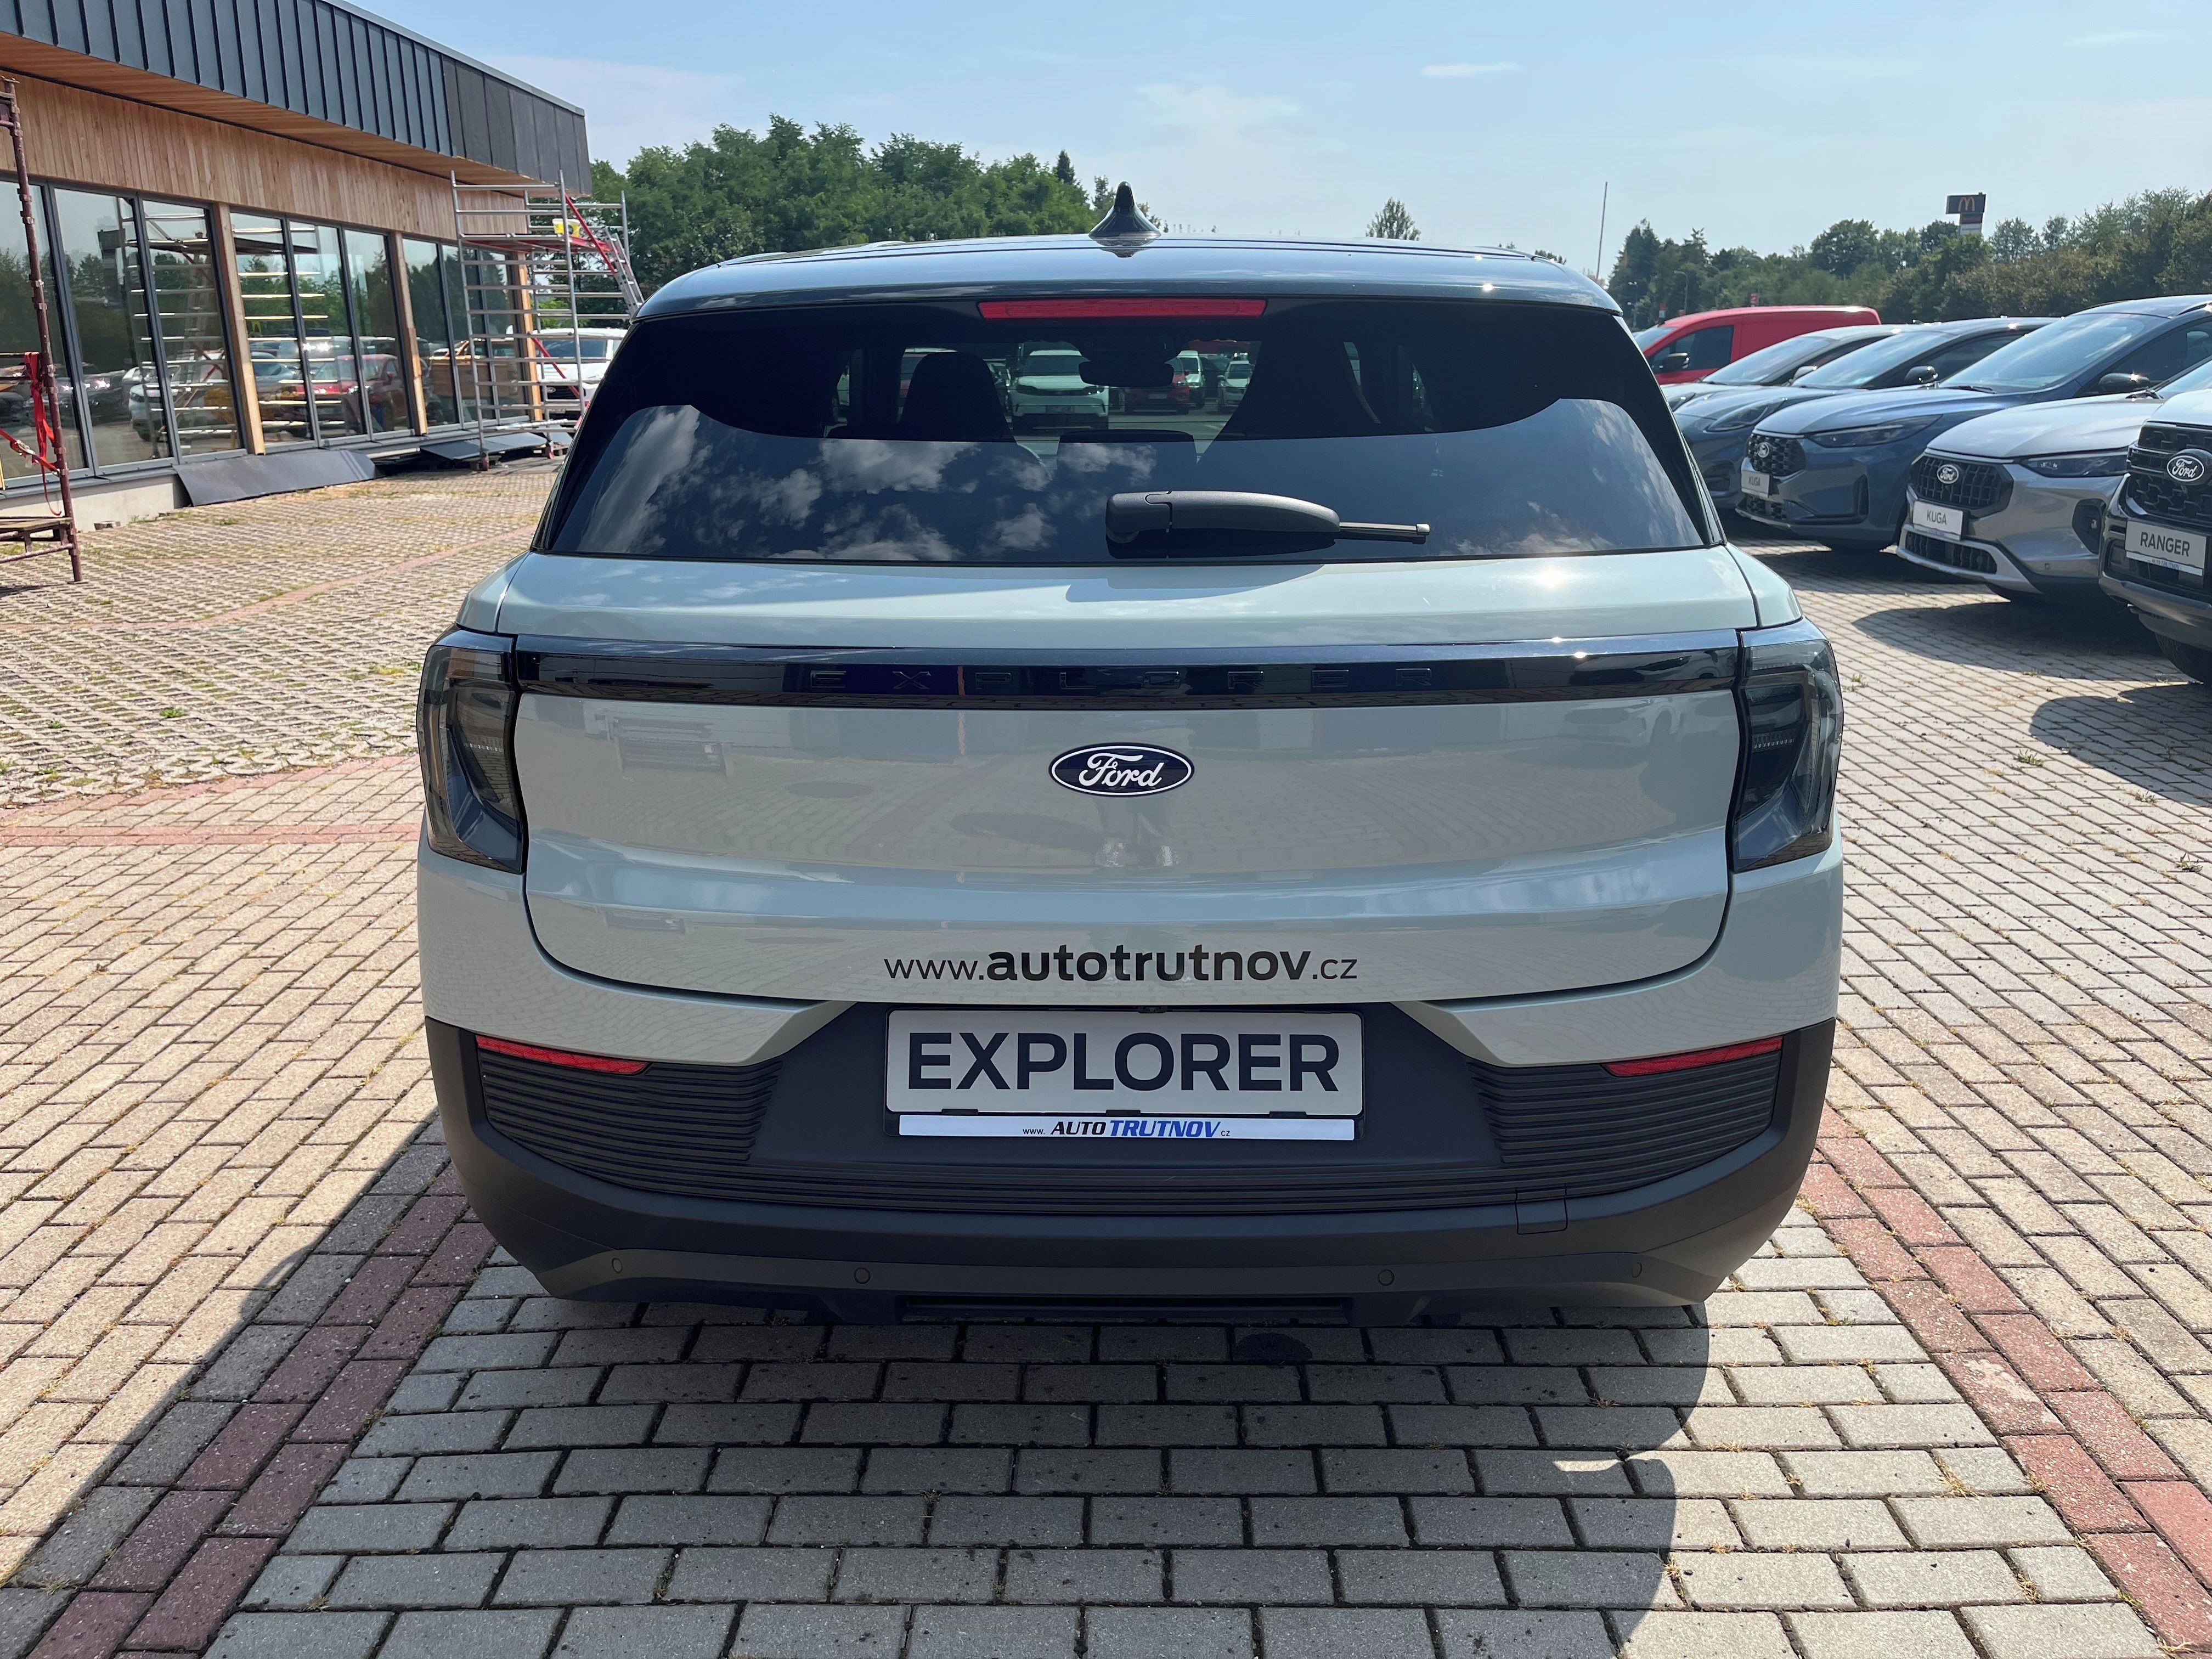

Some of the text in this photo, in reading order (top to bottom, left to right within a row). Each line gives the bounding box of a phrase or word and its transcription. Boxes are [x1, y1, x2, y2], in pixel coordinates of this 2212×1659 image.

[2171, 458, 2198, 478] Ford
[1926, 510, 1947, 525] KUGA
[2140, 531, 2190, 557] RANGER
[810, 667, 1432, 690] EXPLORER
[1079, 753, 1165, 787] Ford
[884, 944, 1357, 981] www.autotrutnov.cz
[908, 1032, 1340, 1092] EXPLORER
